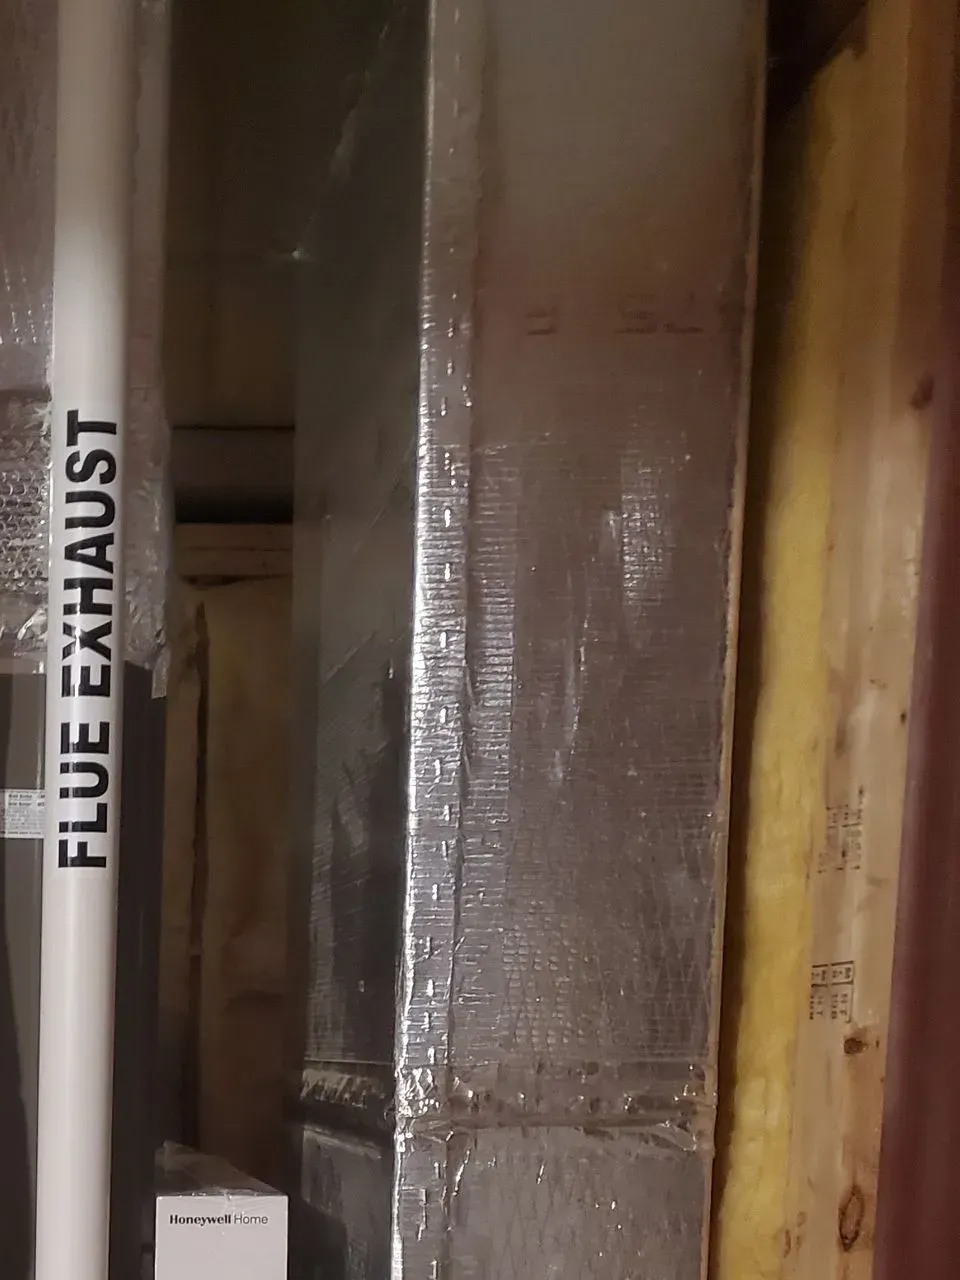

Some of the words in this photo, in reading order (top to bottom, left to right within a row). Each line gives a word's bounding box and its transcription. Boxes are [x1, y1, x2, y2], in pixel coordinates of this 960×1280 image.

[60, 409, 118, 699] EXHAUST
[57, 720, 111, 870] FLUE
[169, 1213, 232, 1227] Honeywell
[233, 1213, 269, 1225] Home
